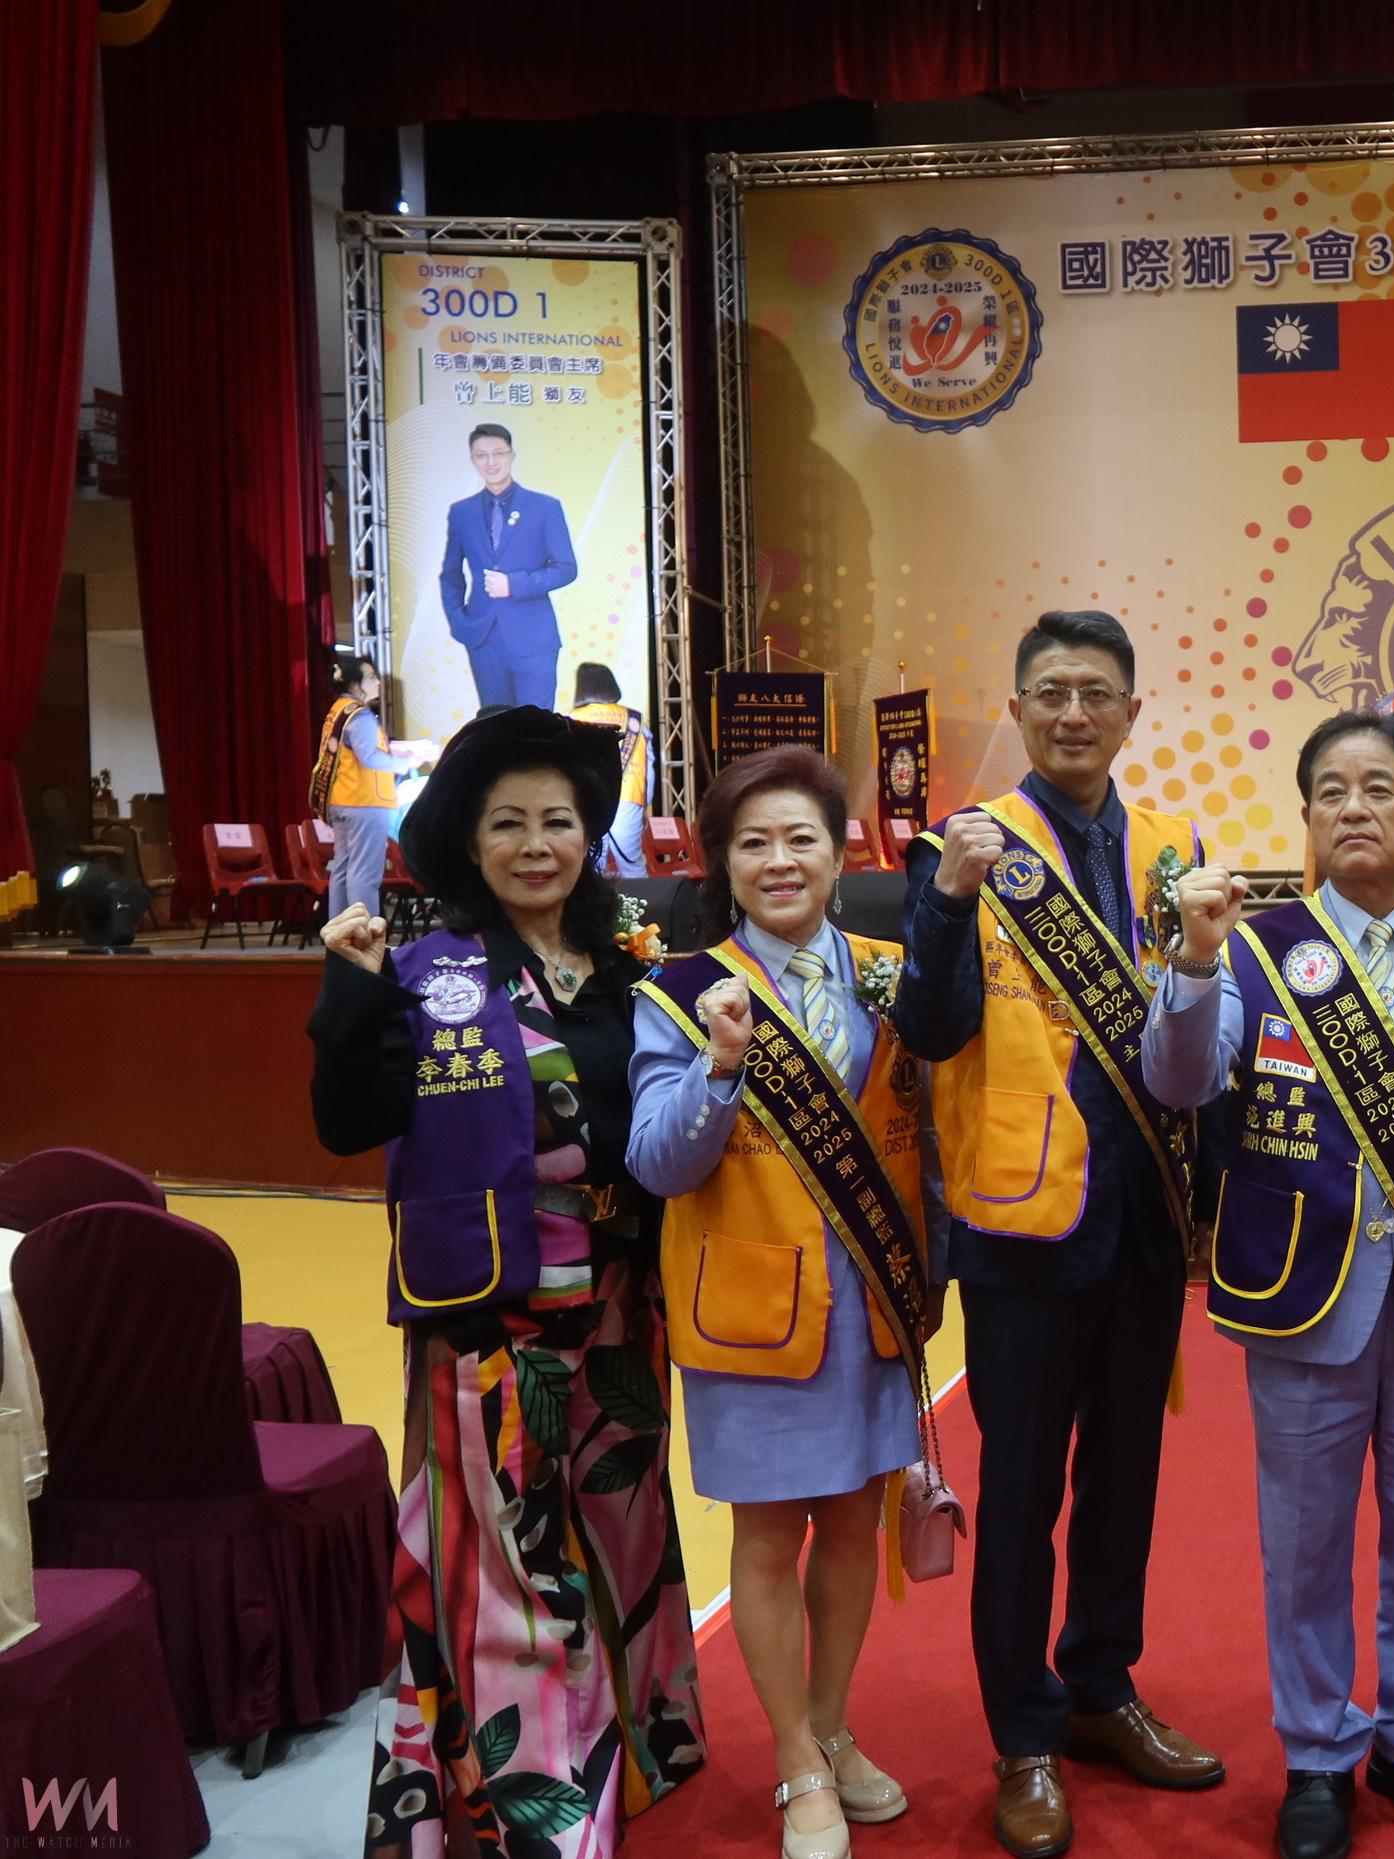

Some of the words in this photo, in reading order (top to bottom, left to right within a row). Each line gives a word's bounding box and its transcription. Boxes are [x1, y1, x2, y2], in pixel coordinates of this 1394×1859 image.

[418, 265, 485, 279] DISTRICT
[901, 281, 983, 295] 2024-2025
[420, 288, 518, 318] 300D
[536, 292, 548, 319] 1
[450, 330, 497, 344] LIONS
[503, 333, 624, 347] INTERNATIONAL
[865, 342, 901, 394] LIONS
[903, 337, 1023, 412] INTERNATIONAL
[911, 377, 931, 389] We
[938, 376, 977, 388] Serve
[1008, 866, 1031, 884] L
[1046, 892, 1121, 991] 國際獅子會
[1093, 987, 1132, 1022] 2024
[1105, 1005, 1143, 1042] 2025
[432, 1026, 484, 1051] 總監
[752, 1020, 829, 1114] 國際獅子會
[1264, 1060, 1308, 1077] TAIWAN
[417, 1077, 480, 1097] CHUEN-CHI
[482, 1074, 504, 1088] LEE
[1255, 1081, 1306, 1107] 總監
[801, 1110, 840, 1146] 2024
[743, 1143, 771, 1155] CHAO
[814, 1127, 852, 1164] 2025
[1261, 1136, 1287, 1157] CHIN
[1289, 1140, 1319, 1161] HSIN
